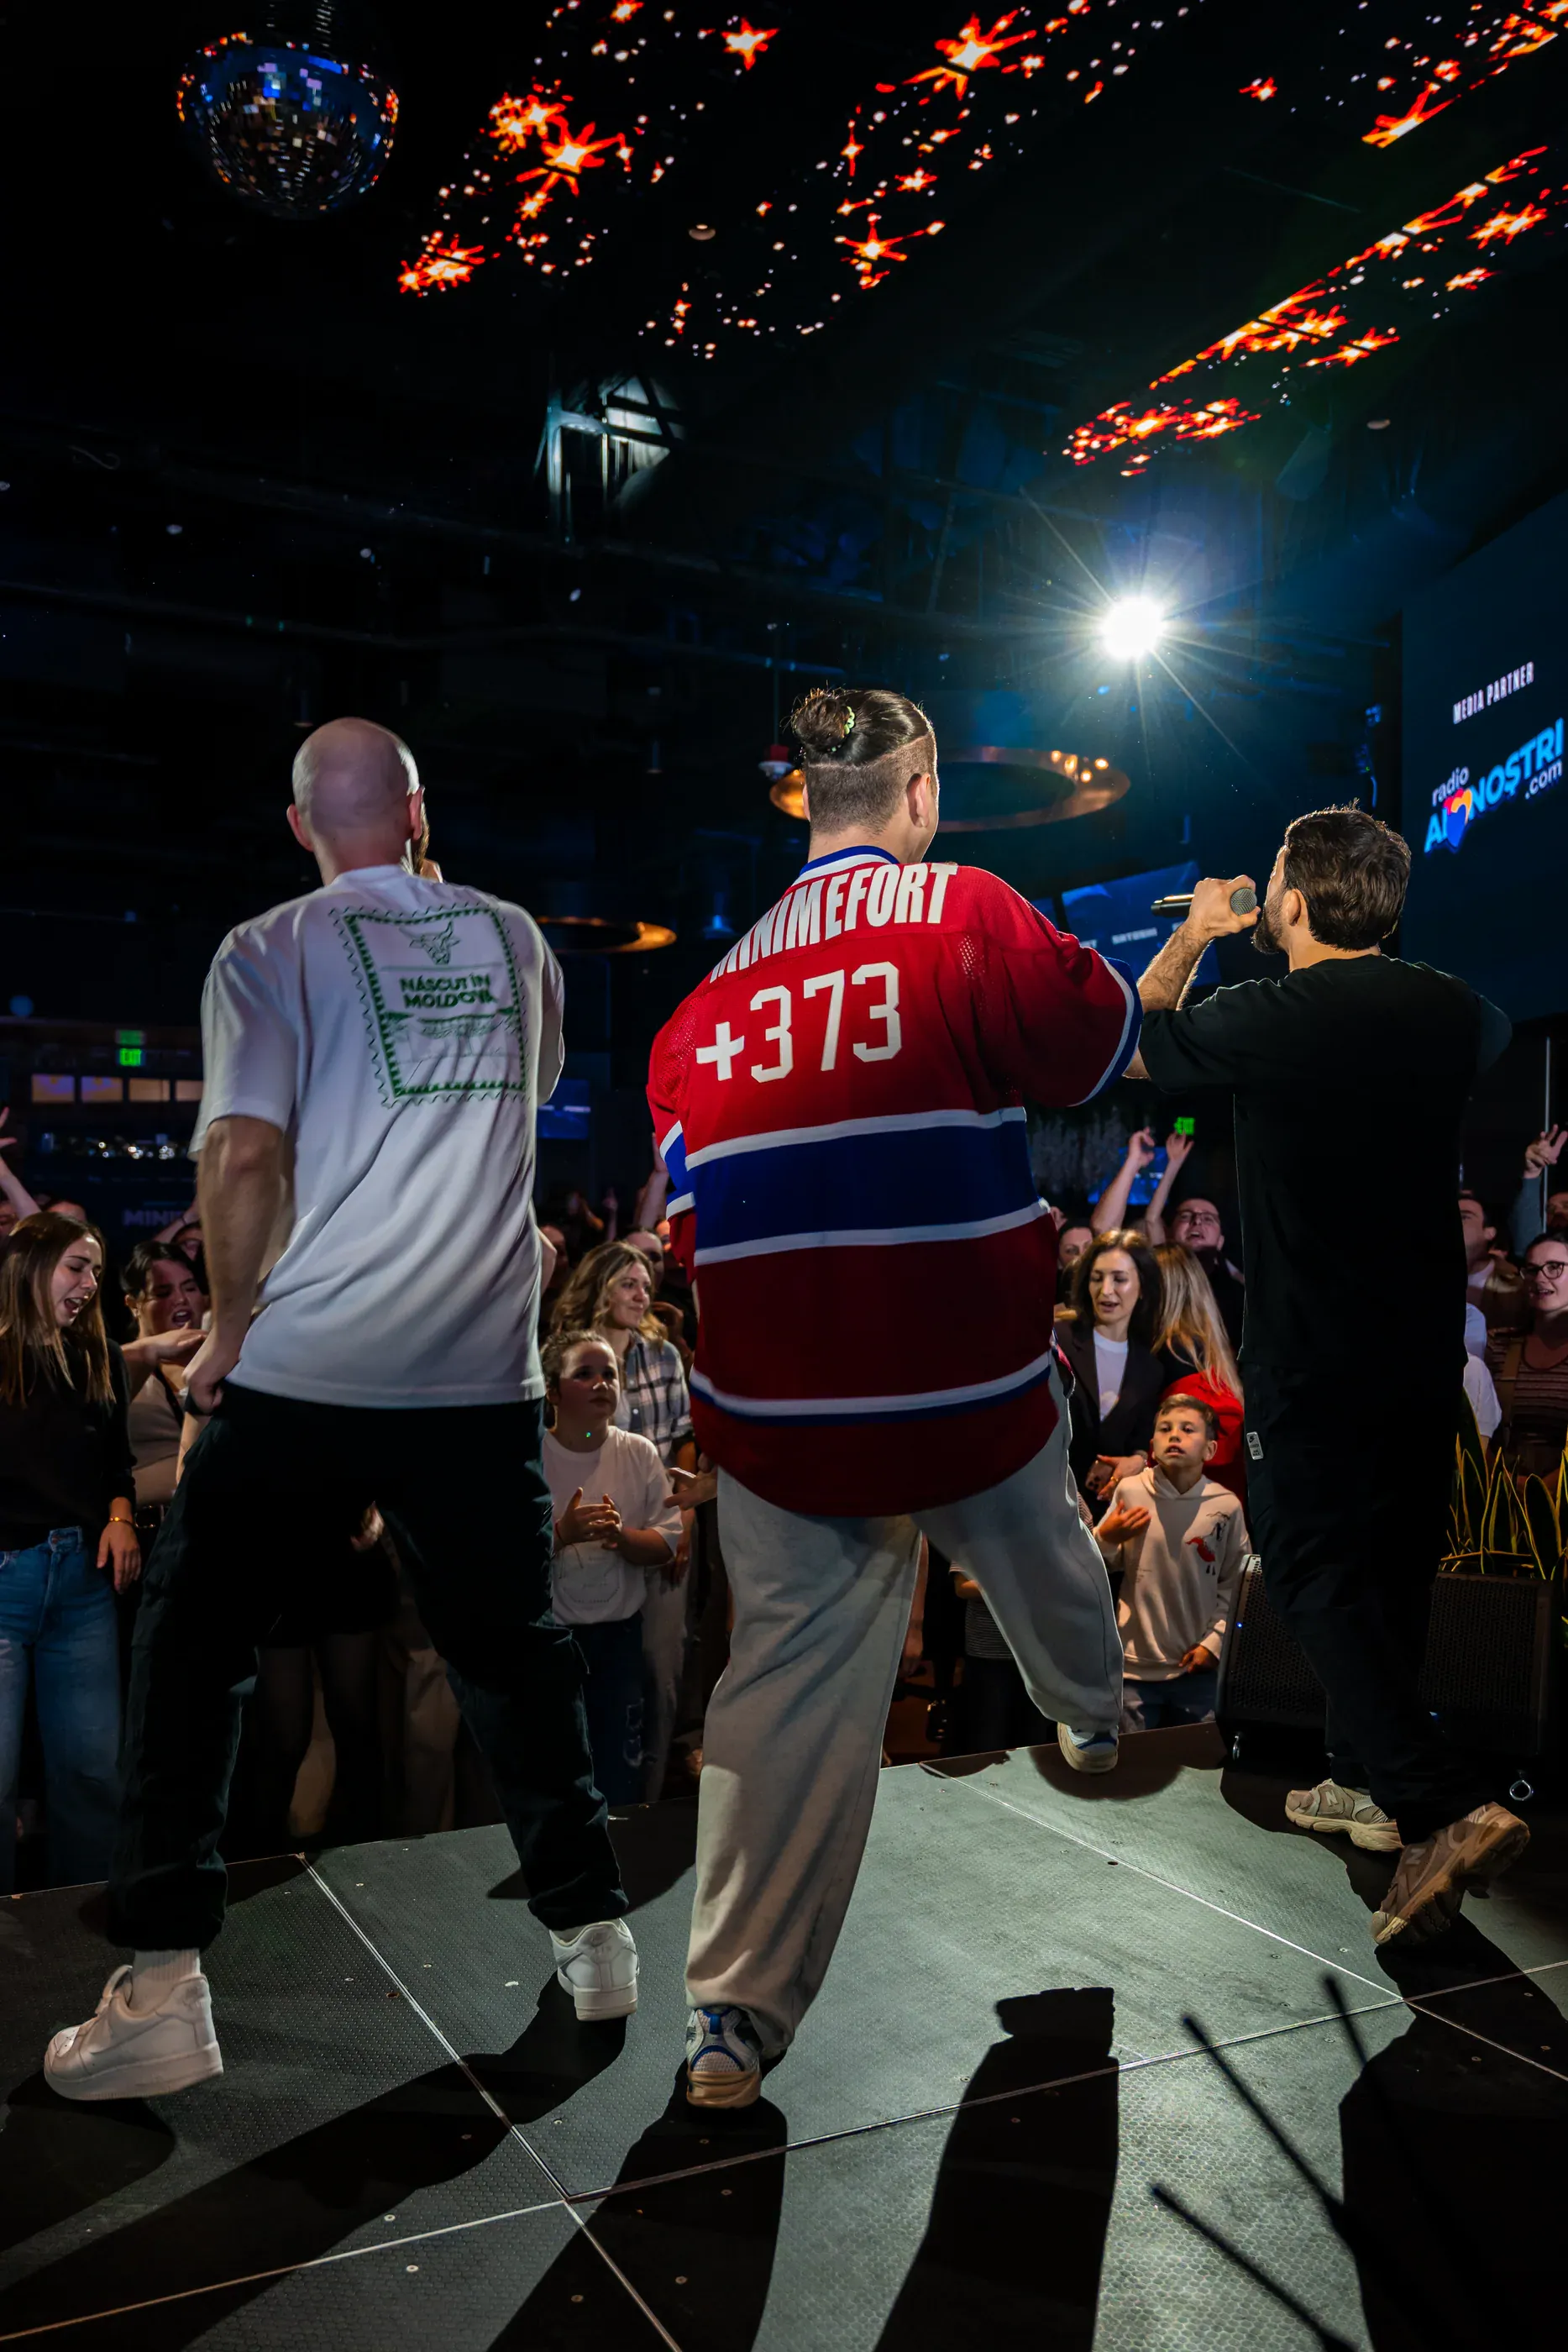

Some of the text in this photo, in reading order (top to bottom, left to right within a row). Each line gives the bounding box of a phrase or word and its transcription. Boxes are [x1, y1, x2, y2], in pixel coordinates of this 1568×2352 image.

[1453, 661, 1534, 725] MEDIA PARTNER
[1432, 766, 1469, 806] radio
[695, 961, 902, 1083] +373
